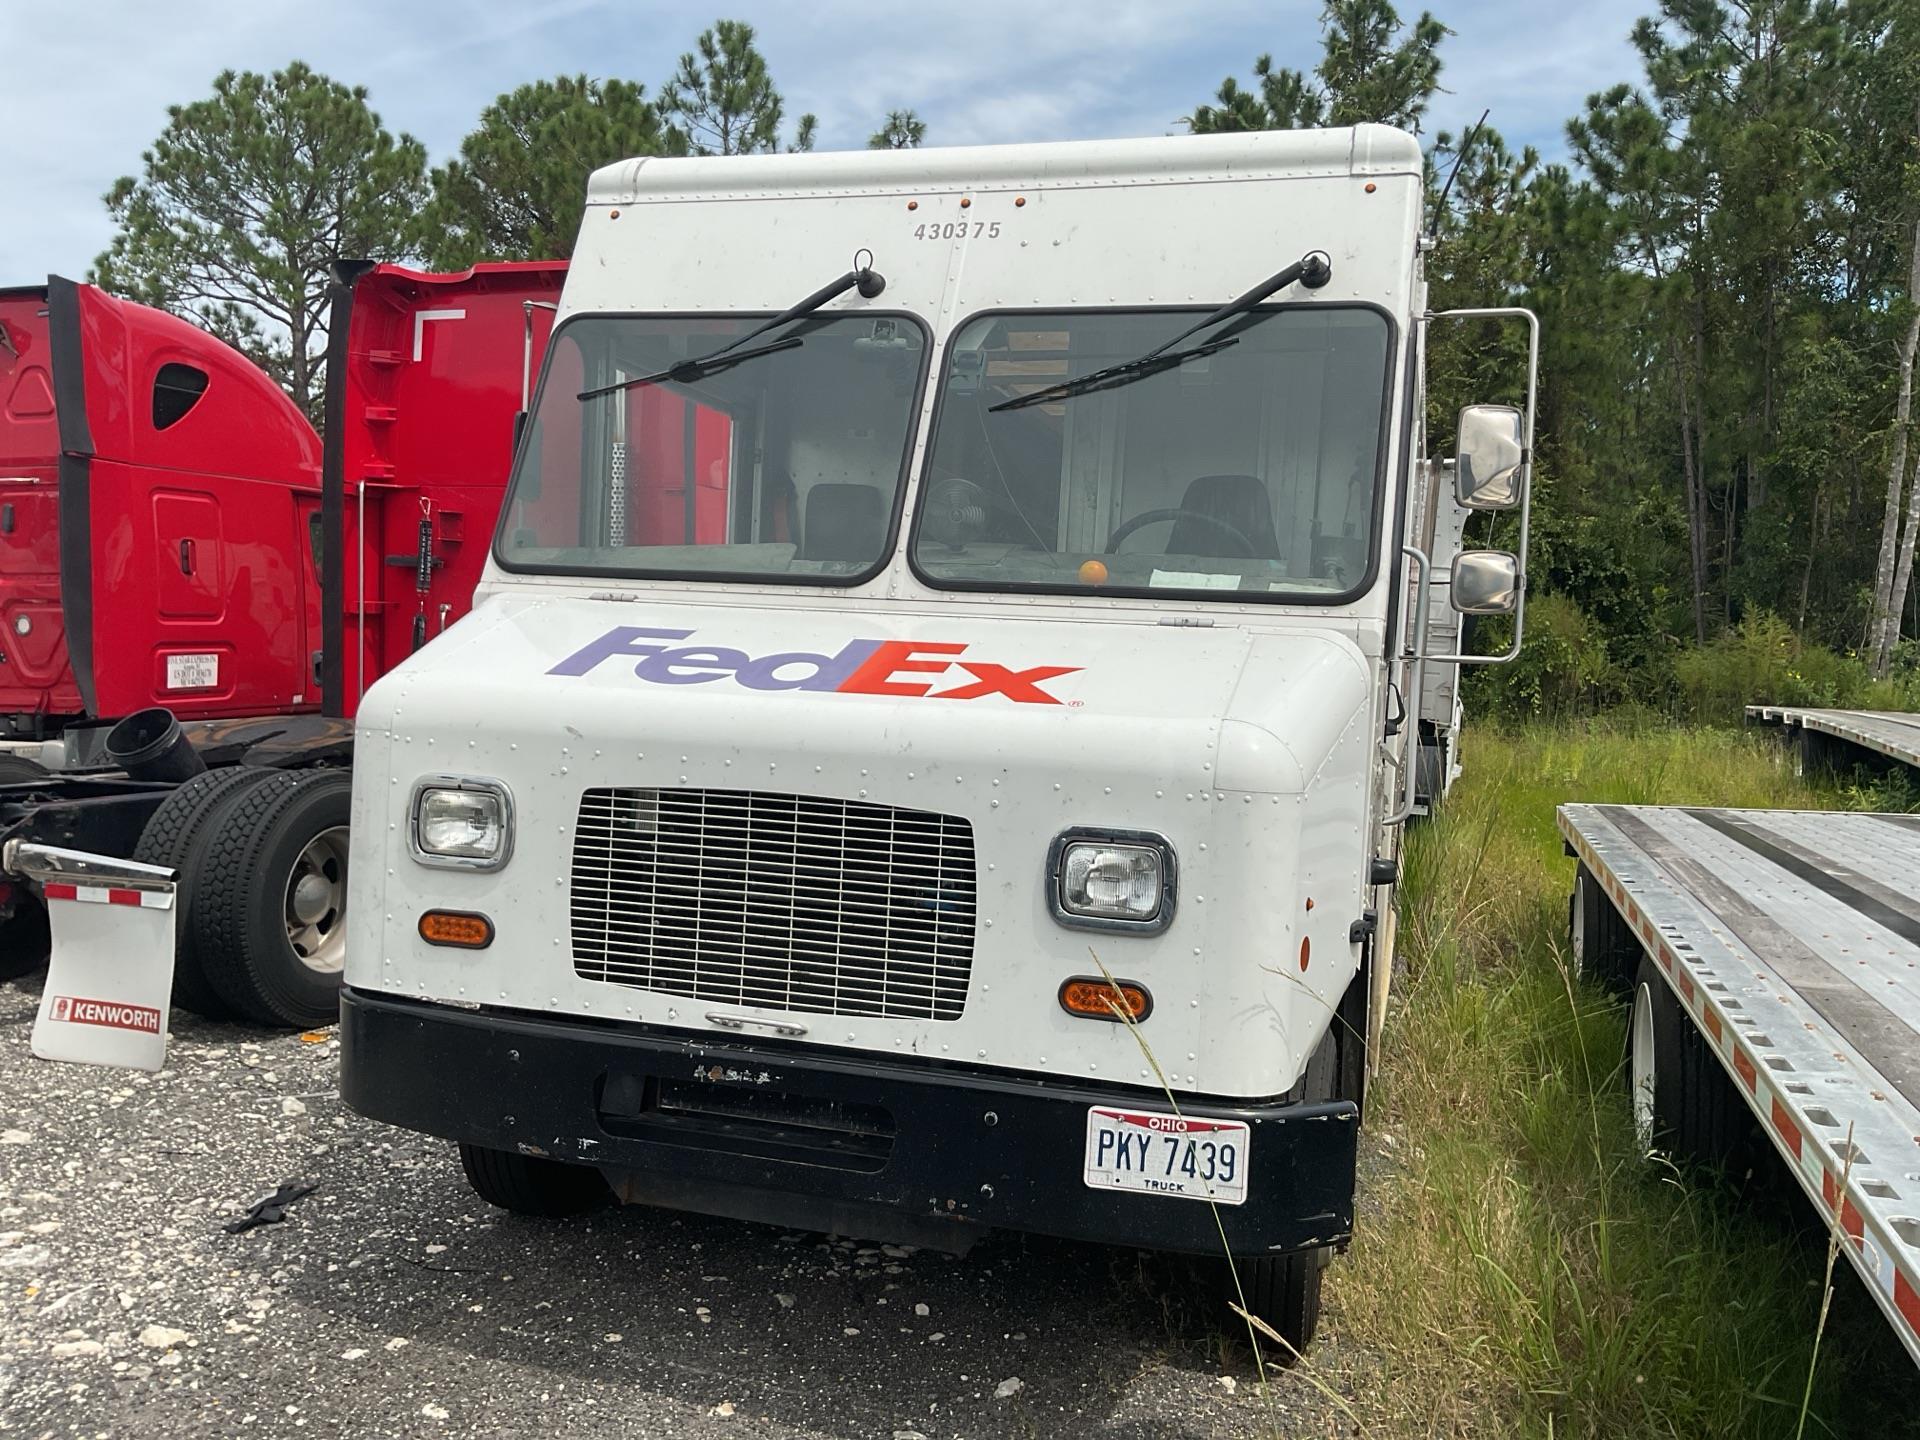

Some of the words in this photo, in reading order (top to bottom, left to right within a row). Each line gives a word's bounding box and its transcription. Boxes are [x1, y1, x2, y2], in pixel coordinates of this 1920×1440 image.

[914, 222, 1002, 241] 430375
[543, 625, 1088, 706] FedEx
[74, 1002, 158, 1030] KENWORTH
[1148, 1118, 1188, 1132] OHIO
[1097, 1129, 1152, 1173] PKY
[1164, 1137, 1236, 1182] 7439
[1144, 1179, 1185, 1192] TRUCK
